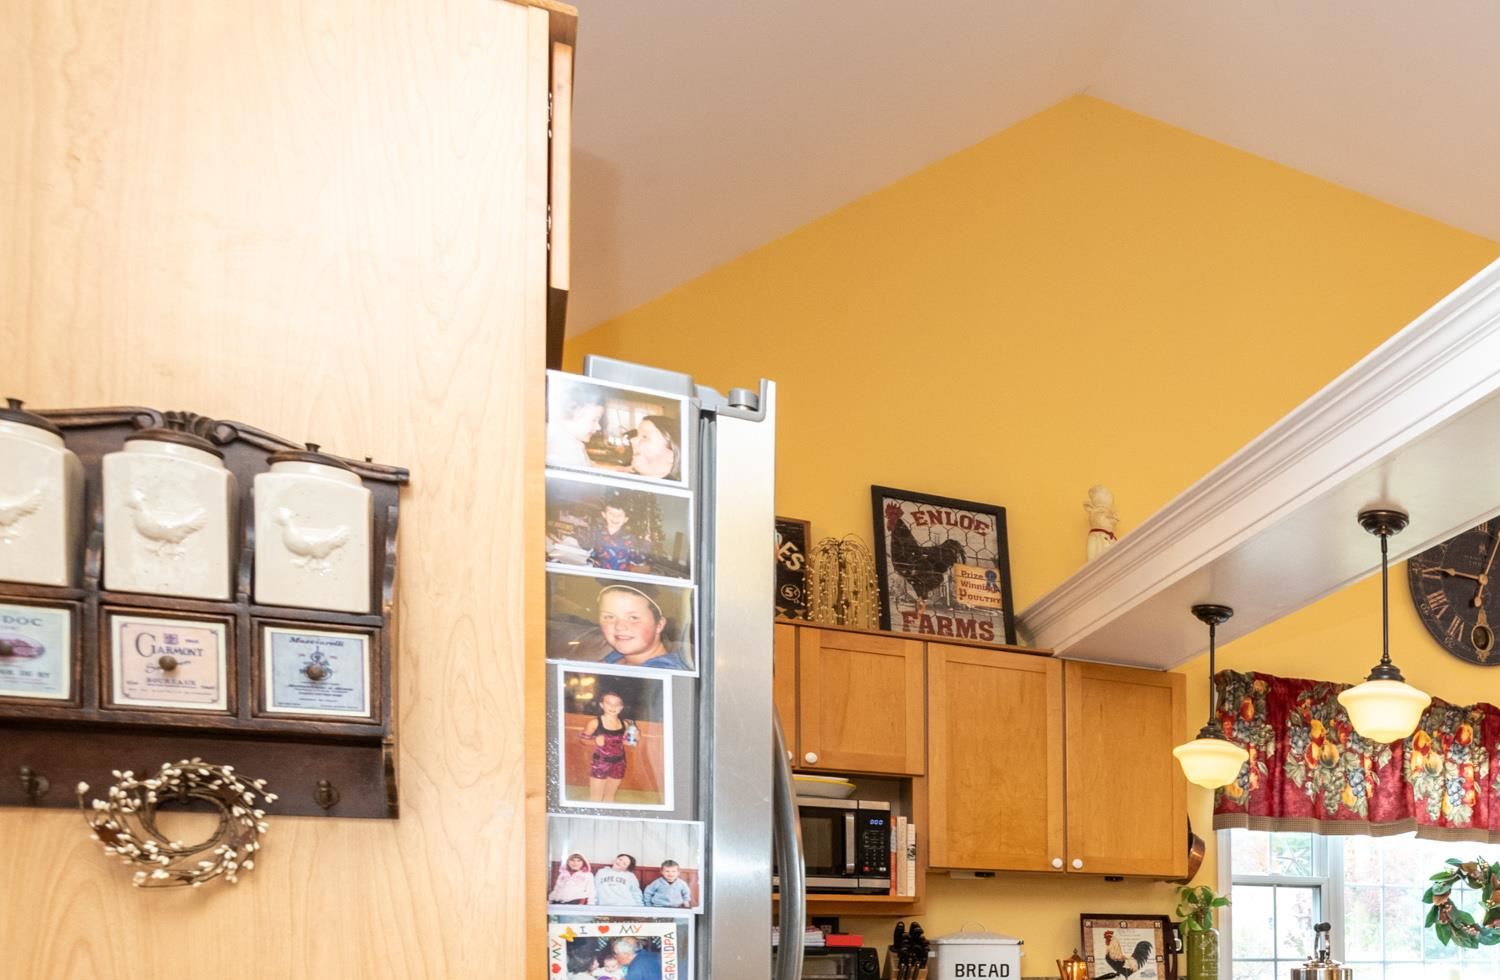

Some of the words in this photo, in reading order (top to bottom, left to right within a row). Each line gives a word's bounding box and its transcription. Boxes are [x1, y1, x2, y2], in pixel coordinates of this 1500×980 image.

[911, 510, 990, 536] ENLOE
[961, 571, 984, 579] Prize
[902, 611, 995, 641] FARMS
[620, 925, 642, 934] MY
[664, 931, 675, 980] GRANDPA
[955, 963, 1010, 978] BREAD
